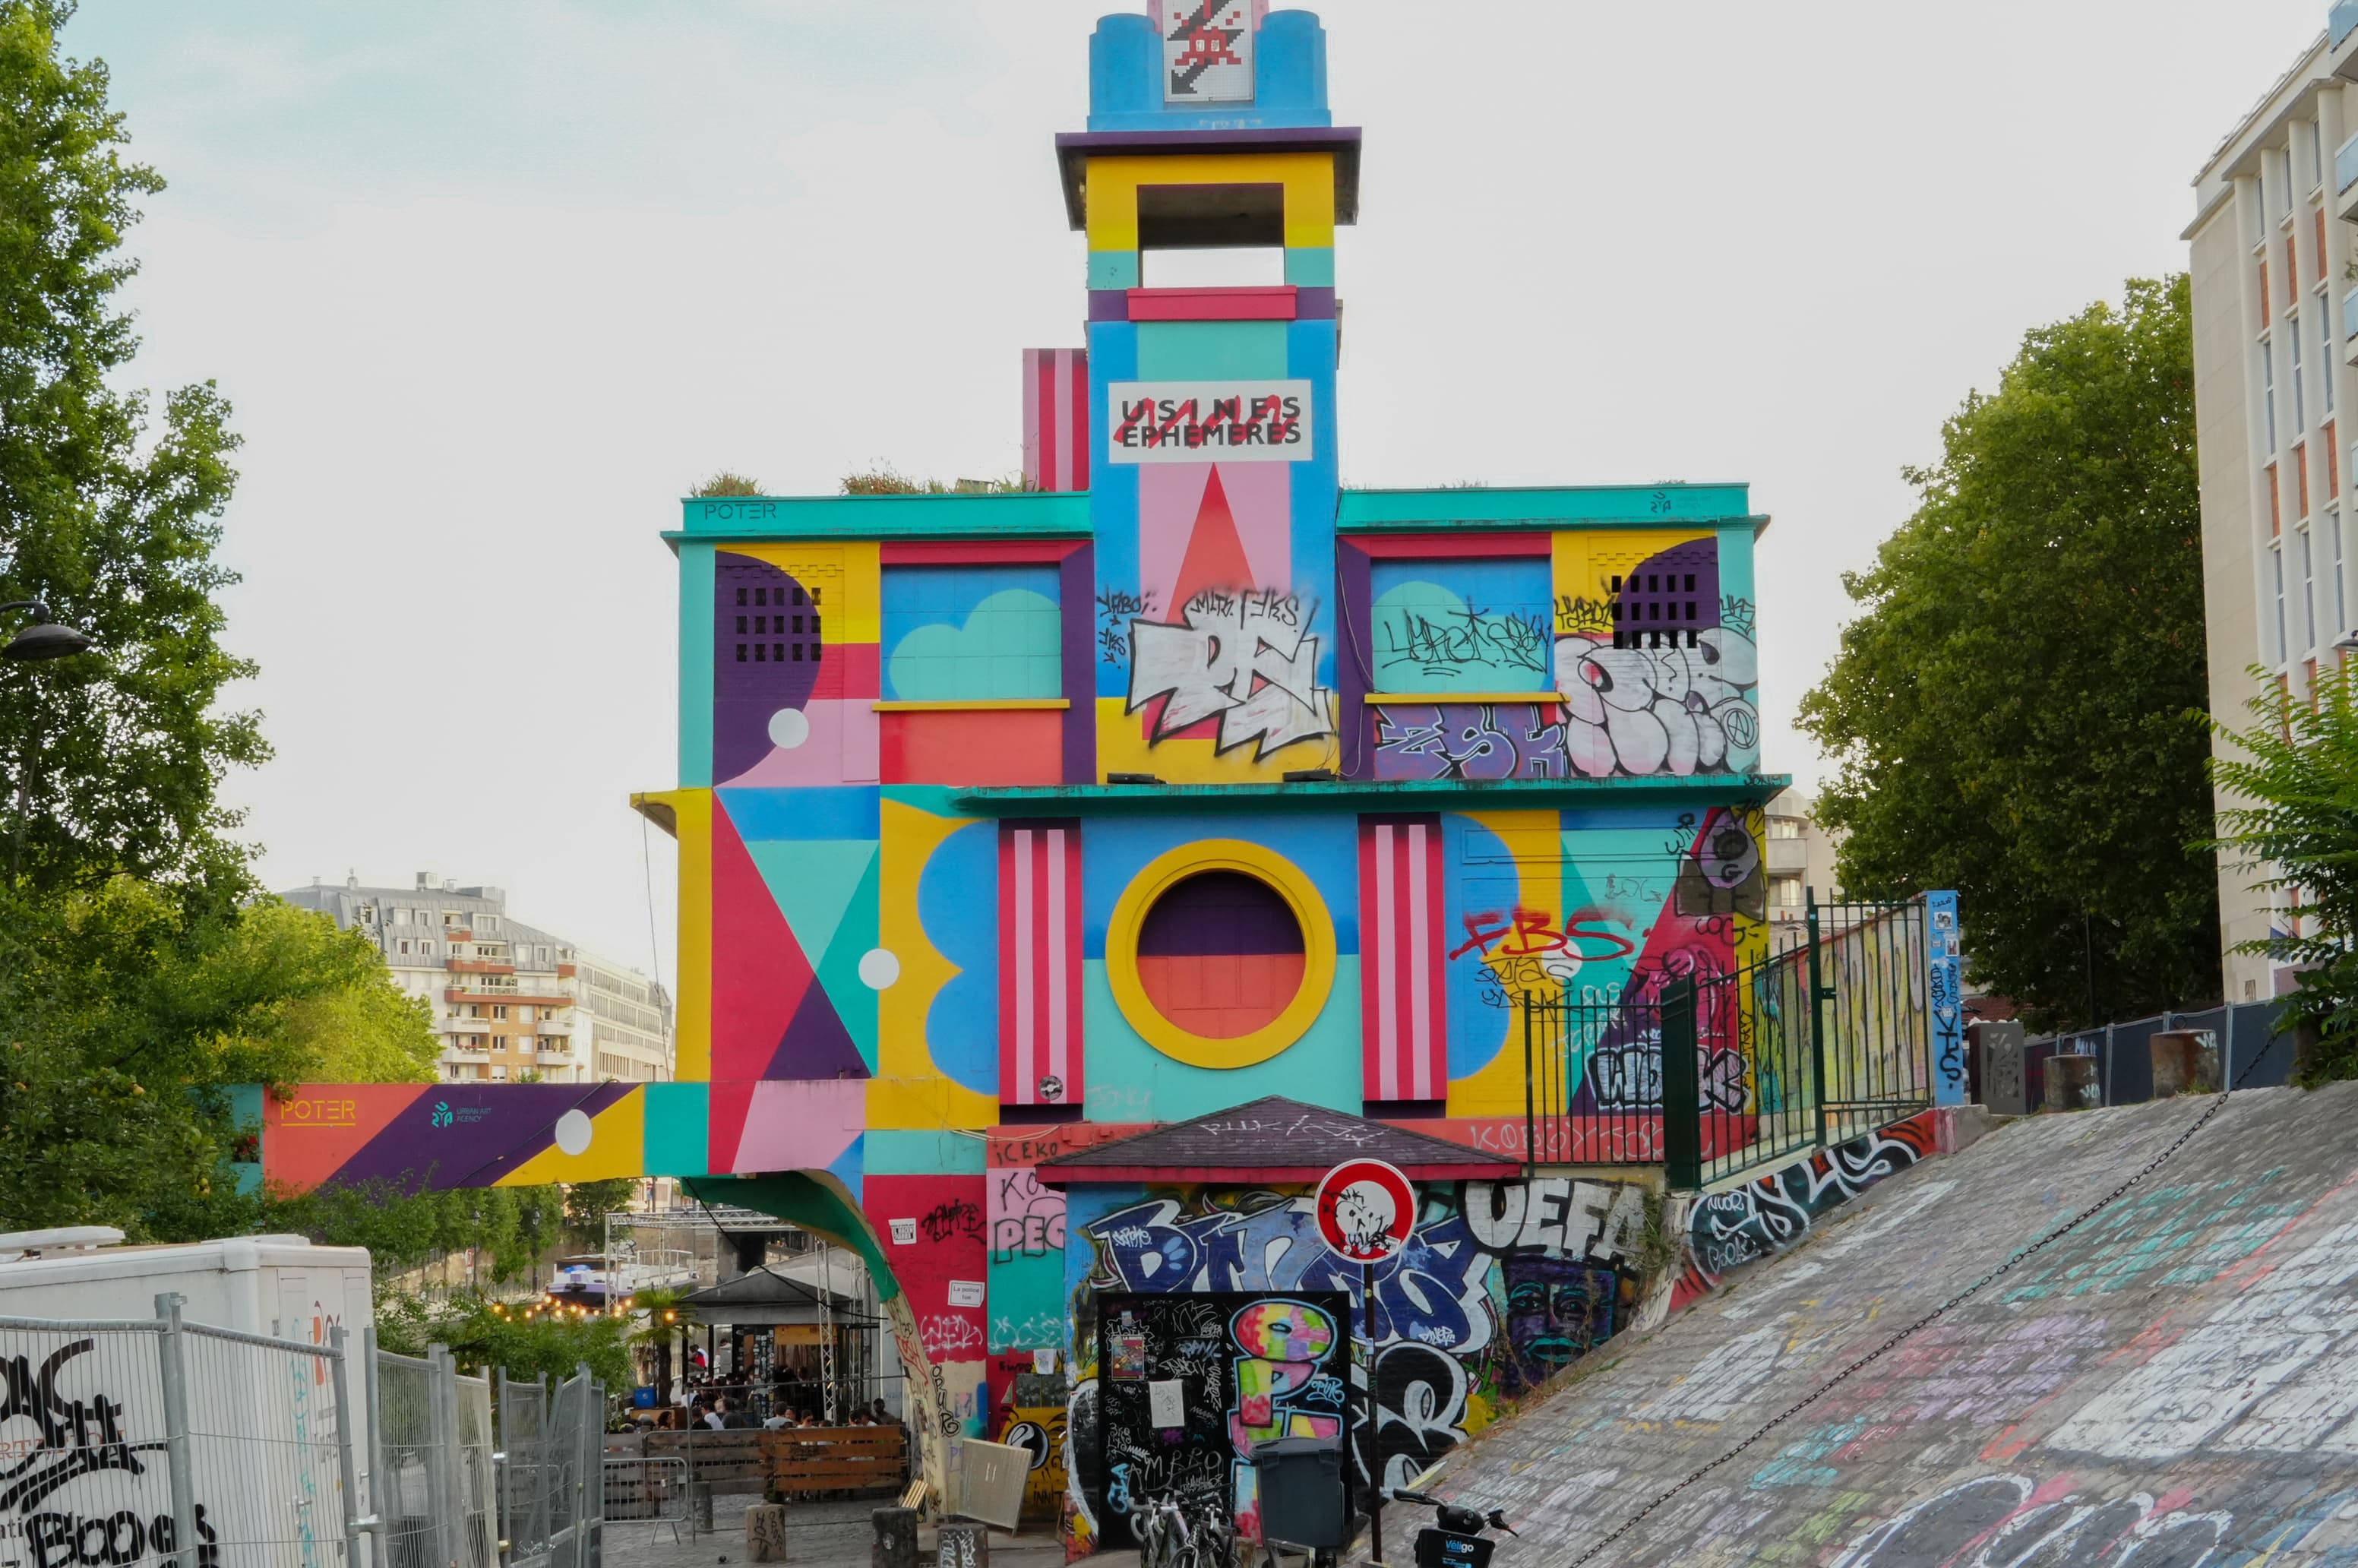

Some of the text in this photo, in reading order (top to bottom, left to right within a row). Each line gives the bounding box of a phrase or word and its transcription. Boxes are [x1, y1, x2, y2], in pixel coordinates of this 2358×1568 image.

[1121, 396, 1301, 422] USINES
[1122, 422, 1301, 447] EPHEMERES
[705, 504, 777, 520] POTER
[280, 1101, 356, 1120] POTER
[1446, 1539, 1475, 1554] Véligo
